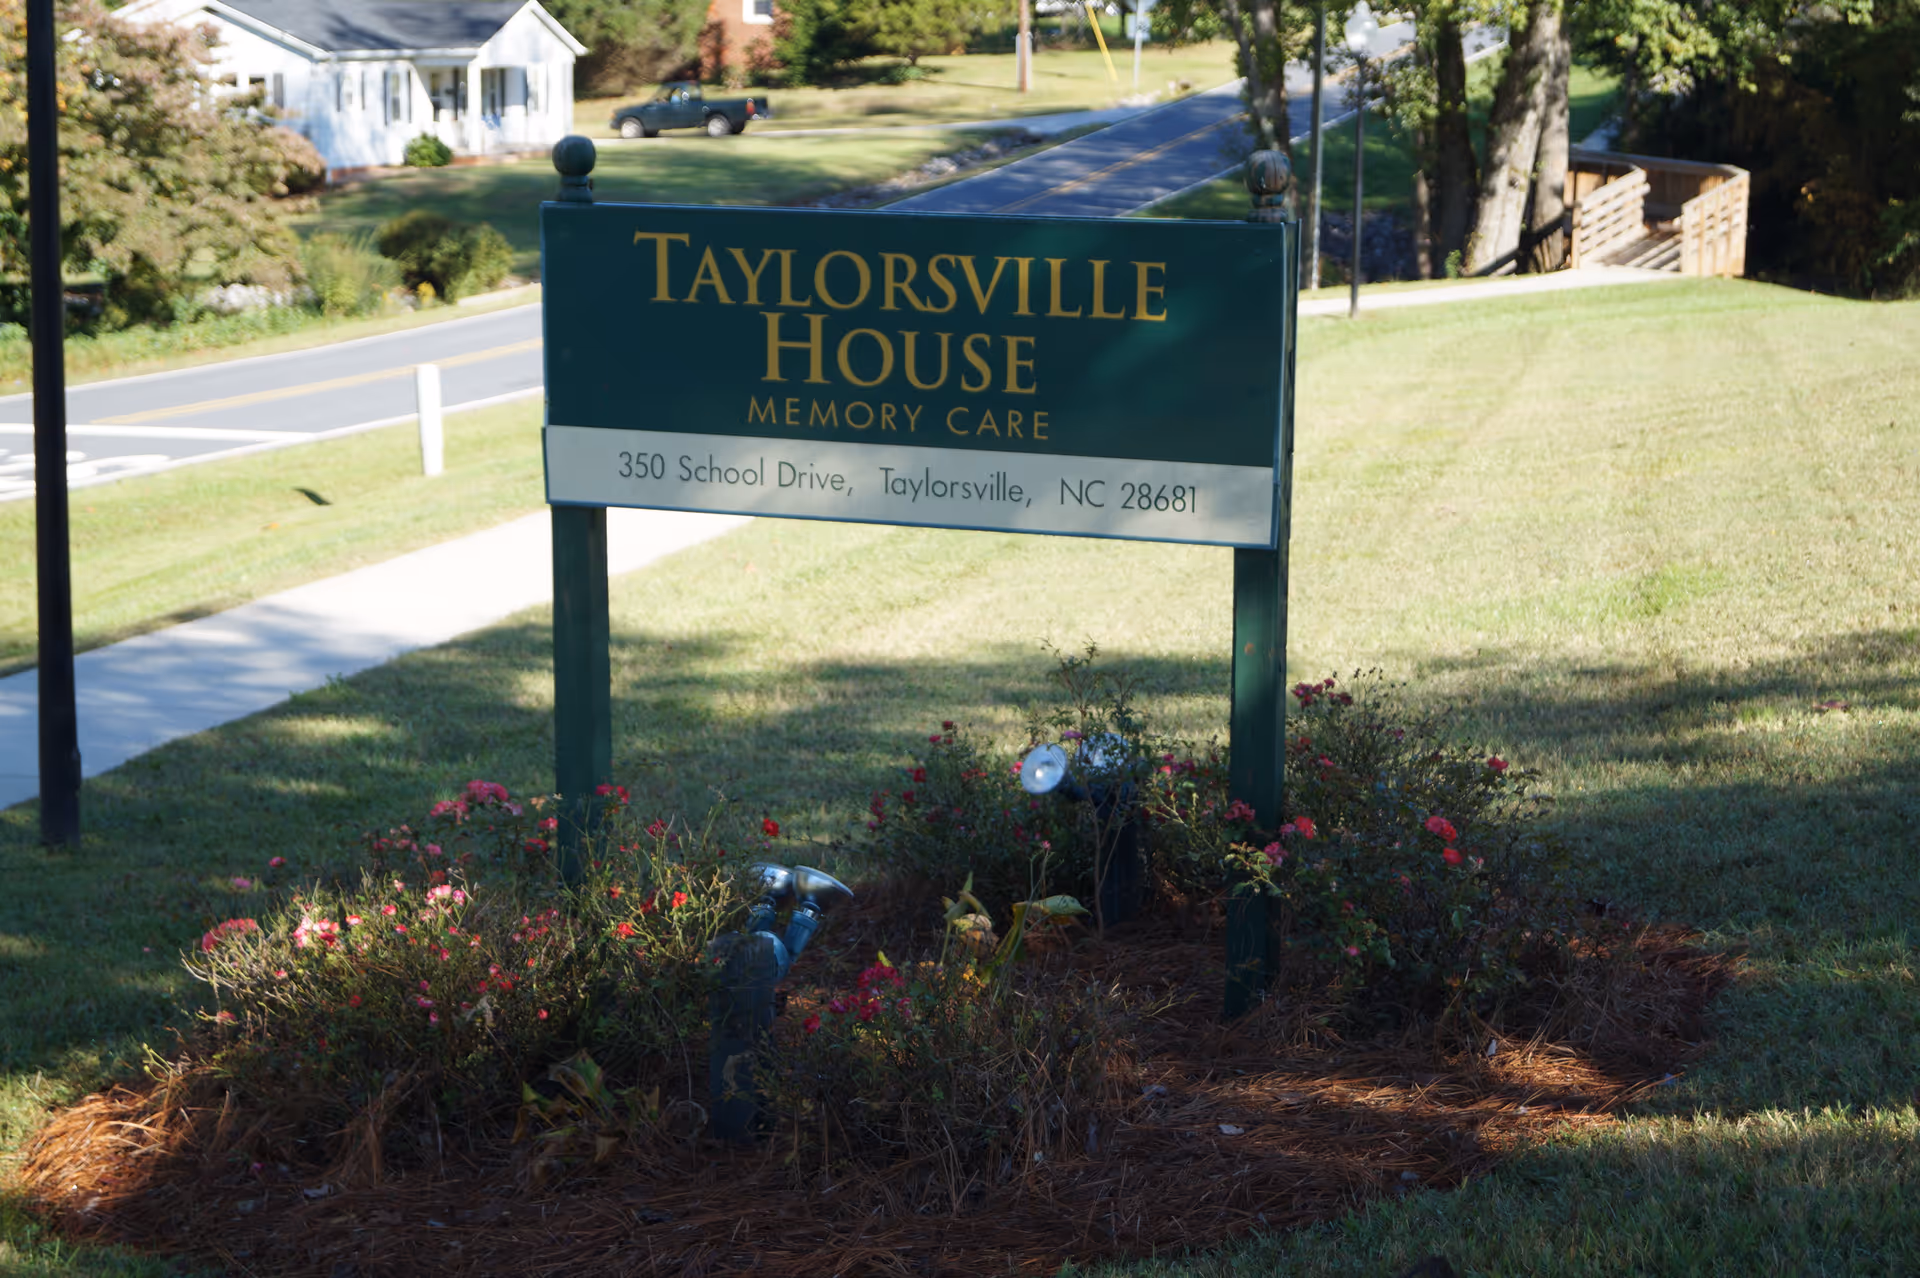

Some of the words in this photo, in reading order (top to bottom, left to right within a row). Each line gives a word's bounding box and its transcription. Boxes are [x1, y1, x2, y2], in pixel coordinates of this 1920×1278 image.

[634, 231, 1168, 322] TAYLORSVILLE
[760, 310, 1037, 394] HOUSE
[747, 396, 923, 431] MEMORY
[946, 406, 1050, 440] CARE
[618, 451, 666, 480] 350
[678, 454, 765, 487] School
[777, 460, 854, 496] Drive,
[878, 466, 1033, 509] Taylorsville,
[1059, 476, 1106, 509] NC
[1120, 481, 1198, 514] 28681
